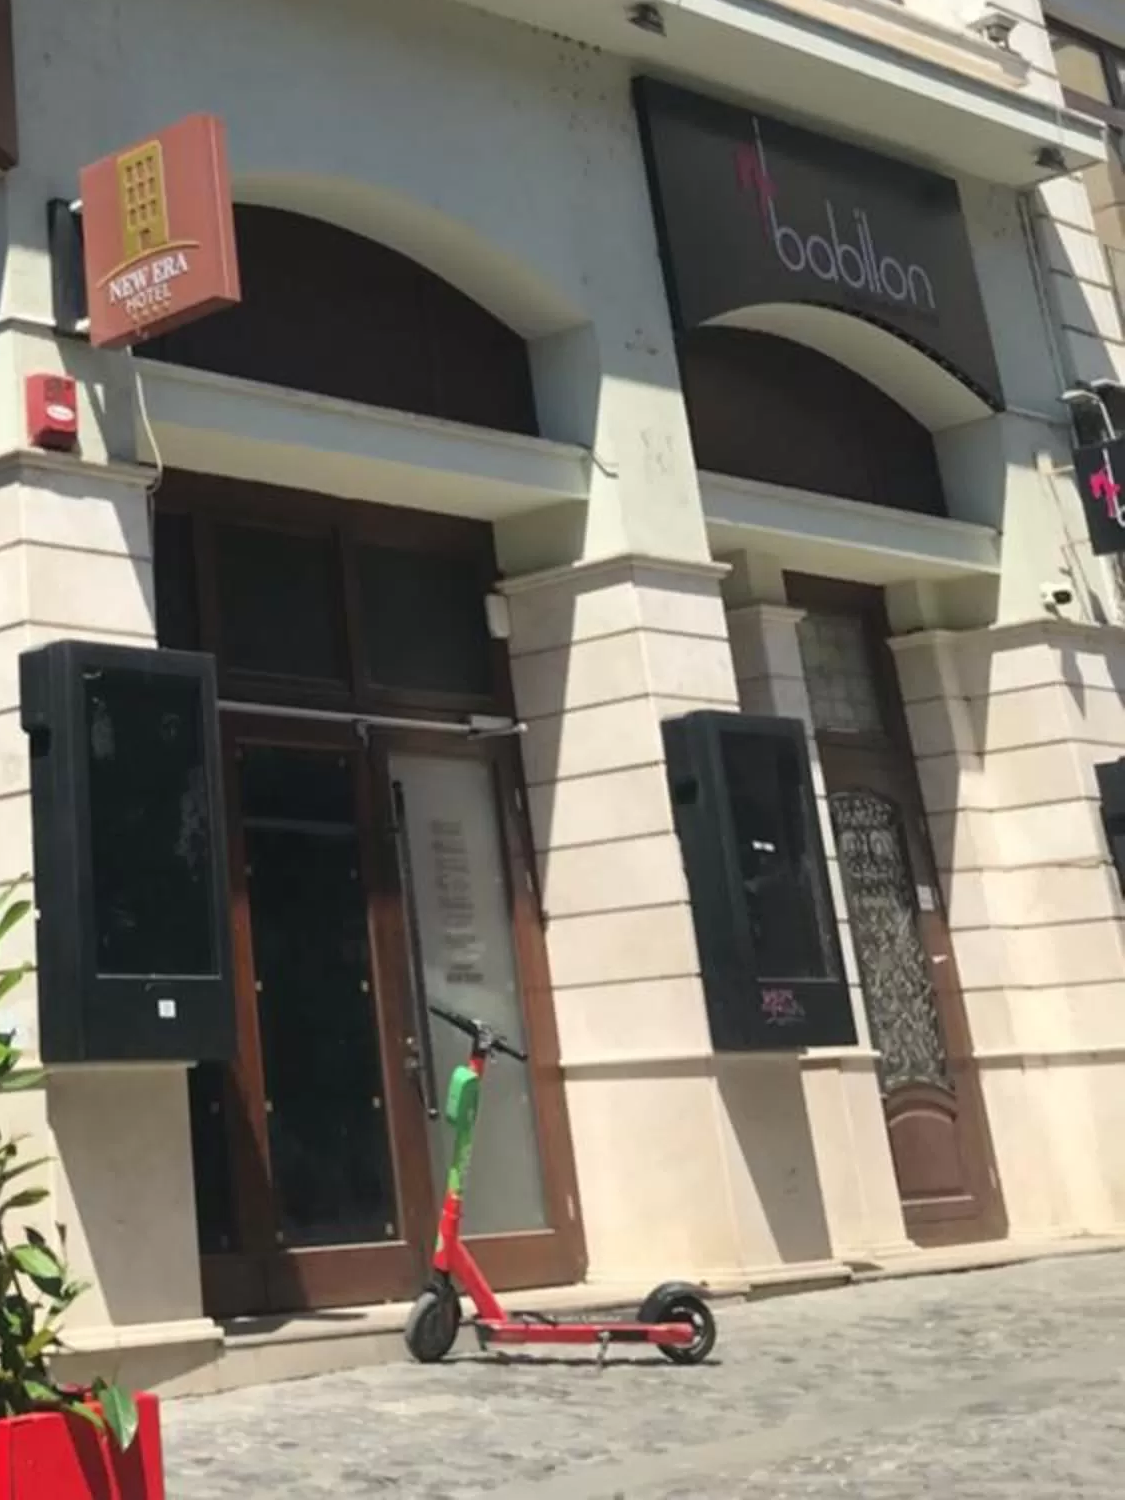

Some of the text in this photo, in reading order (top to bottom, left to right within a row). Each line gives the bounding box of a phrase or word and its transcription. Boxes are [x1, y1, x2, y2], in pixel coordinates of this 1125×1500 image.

[751, 116, 937, 309] babilon
[109, 251, 189, 303] NEW ERA
[125, 281, 173, 314] HOTEL
